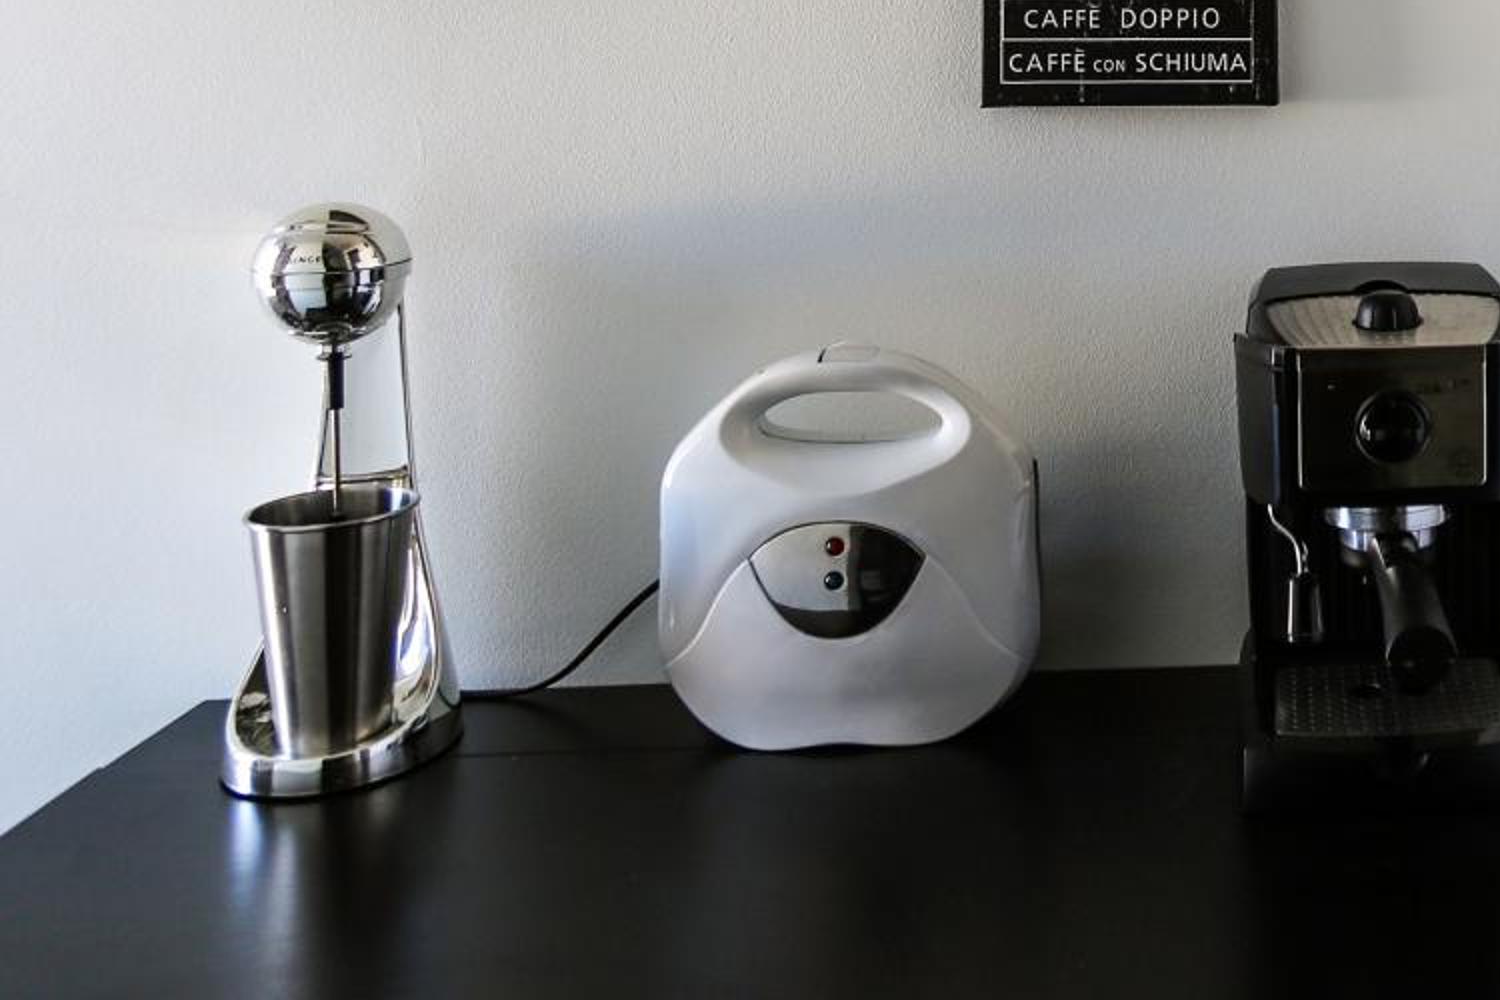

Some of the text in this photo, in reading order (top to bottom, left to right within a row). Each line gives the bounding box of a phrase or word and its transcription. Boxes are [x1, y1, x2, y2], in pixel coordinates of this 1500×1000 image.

[1023, 3, 1220, 29] CAFFÈ DOPPIO
[1008, 48, 1247, 73] CAFFÈ CON SCHIUMA
